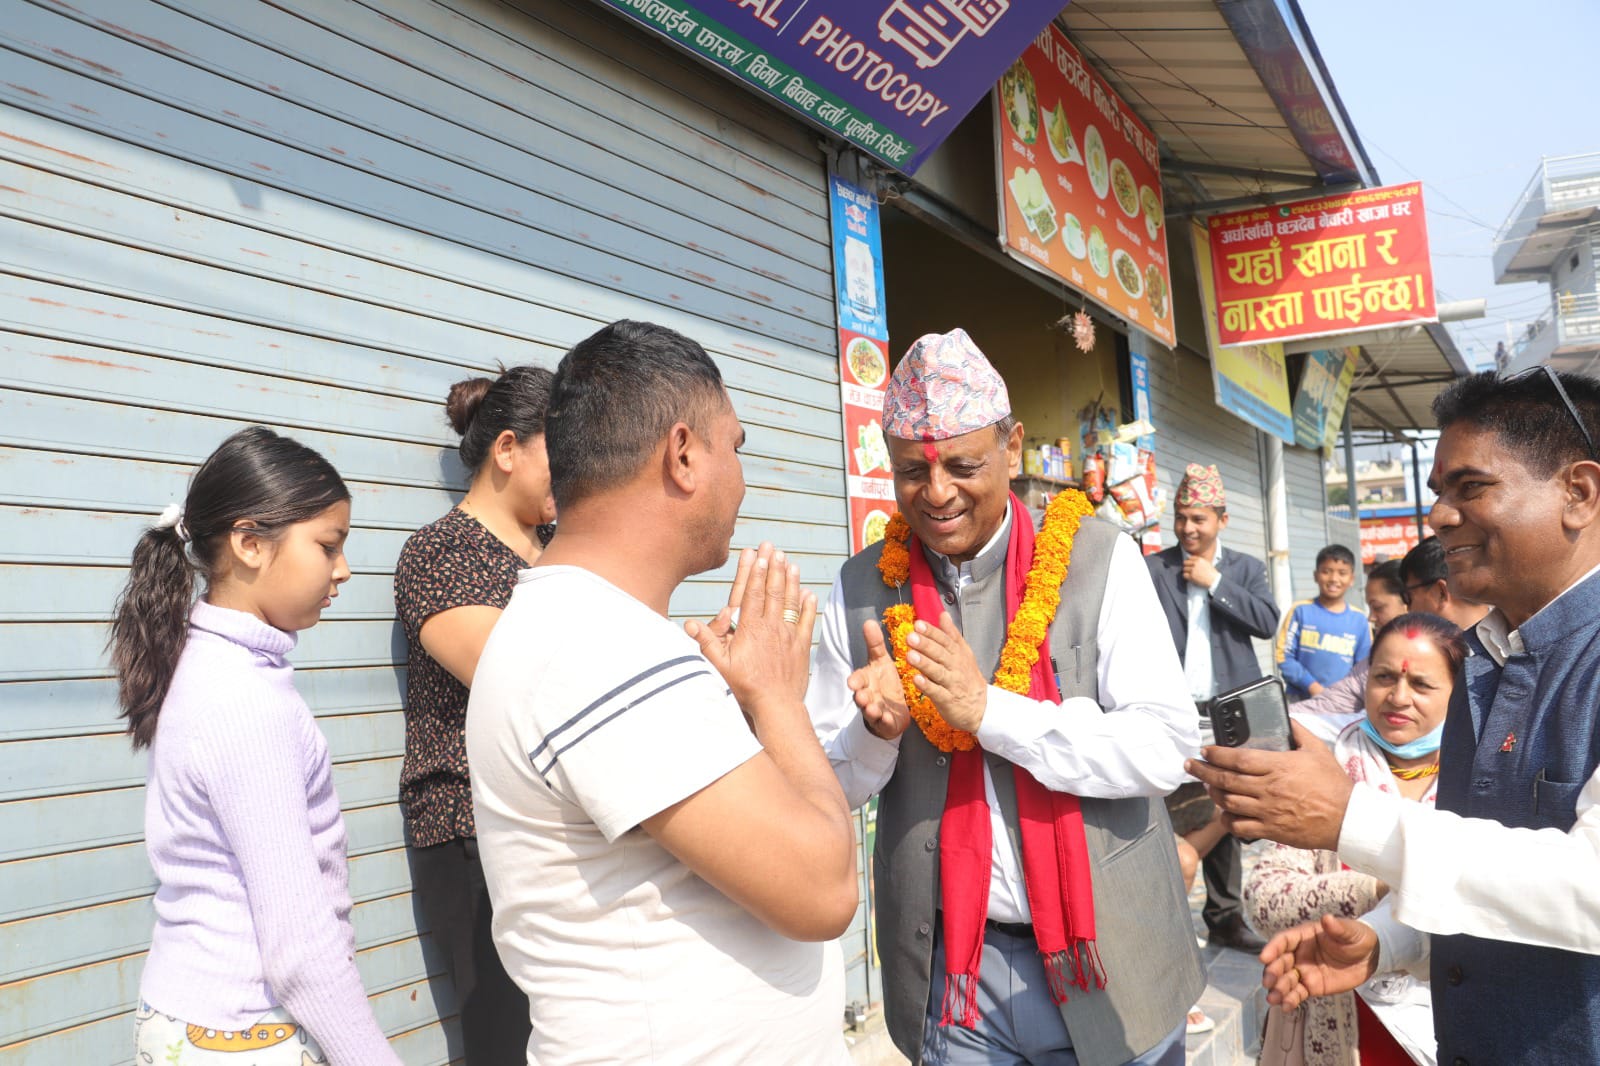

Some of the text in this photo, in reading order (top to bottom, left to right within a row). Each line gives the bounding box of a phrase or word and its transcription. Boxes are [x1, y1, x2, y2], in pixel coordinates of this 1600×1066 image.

[800, 15, 949, 127] PHOTOCOPY
[1356, 204, 1389, 223] खाजा
[1392, 200, 1411, 217] घर
[1227, 228, 1399, 286] यहाँ खाना र
[1222, 291, 1304, 332] नास्ता
